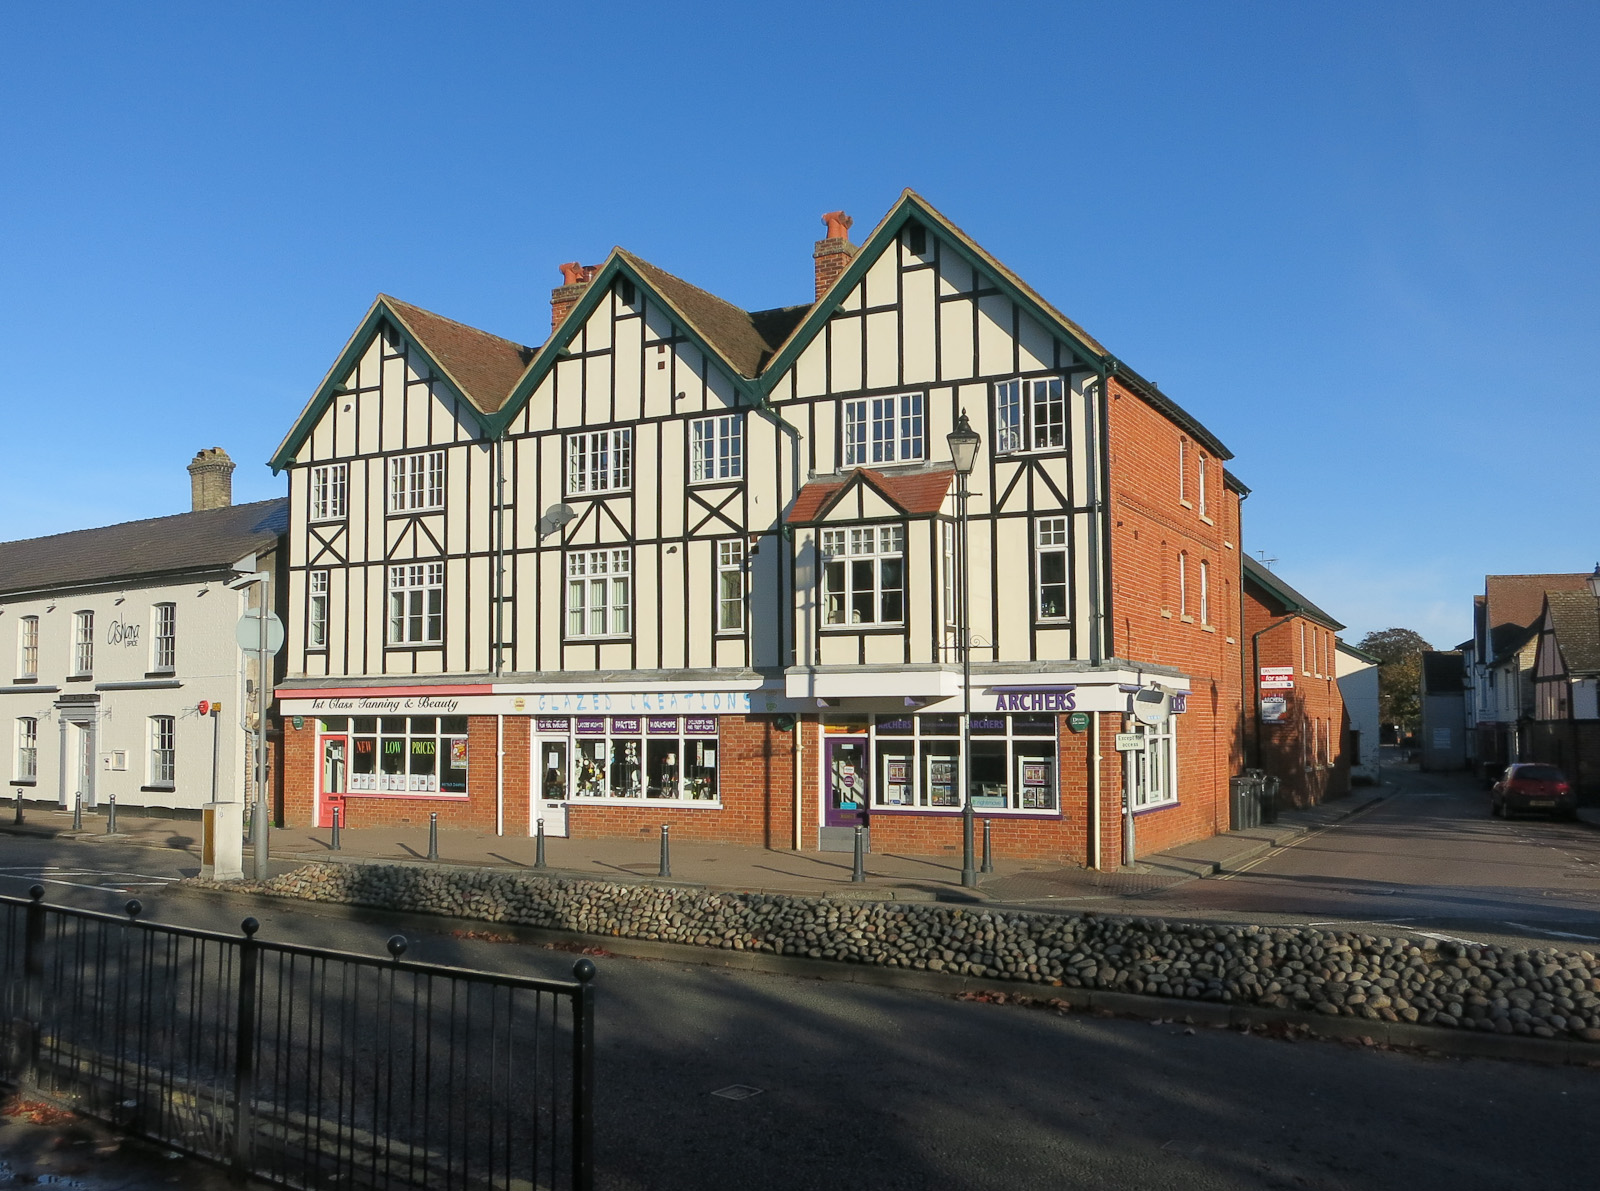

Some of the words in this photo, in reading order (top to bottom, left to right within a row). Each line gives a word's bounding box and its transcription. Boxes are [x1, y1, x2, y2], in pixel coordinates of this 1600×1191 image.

[311, 698, 324, 709] 1st
[328, 698, 354, 709] Class
[358, 697, 400, 712] Tanning
[404, 698, 414, 709] &
[417, 696, 459, 712] Beauty
[538, 694, 612, 711] GLAZED
[630, 693, 751, 710] CREATIONS
[996, 693, 1076, 711] ARCHERS
[615, 720, 637, 729] PARTIES
[649, 720, 676, 729] WORKSHOPS
[878, 720, 912, 730] ARCHERS
[1118, 734, 1135, 743] Except
[356, 741, 373, 754] NEW
[385, 741, 401, 754] LOW
[411, 741, 436, 755] PRICES
